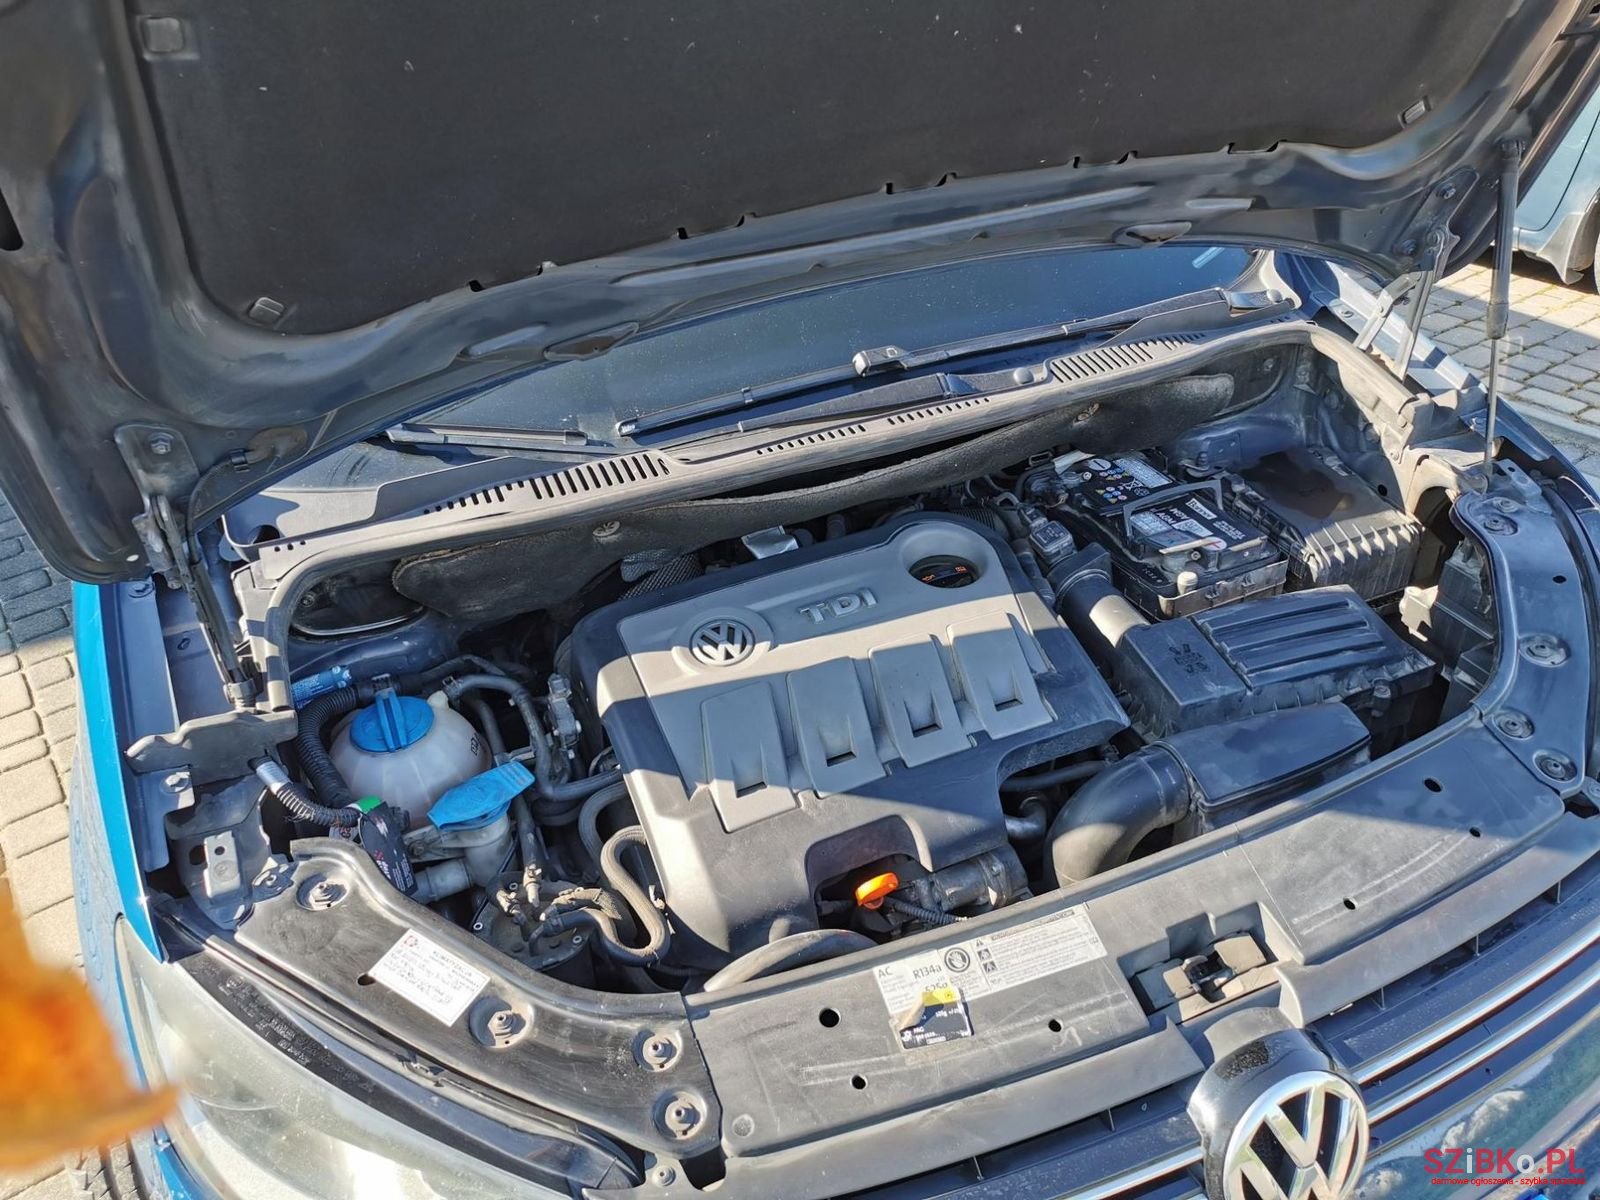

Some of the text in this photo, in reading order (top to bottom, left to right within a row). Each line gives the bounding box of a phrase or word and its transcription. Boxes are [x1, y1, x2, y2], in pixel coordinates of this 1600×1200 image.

[799, 588, 879, 625] TDI
[690, 618, 755, 667] VW
[877, 966, 893, 978] AC
[912, 963, 942, 980] R134a
[1224, 1072, 1370, 1200] VW
